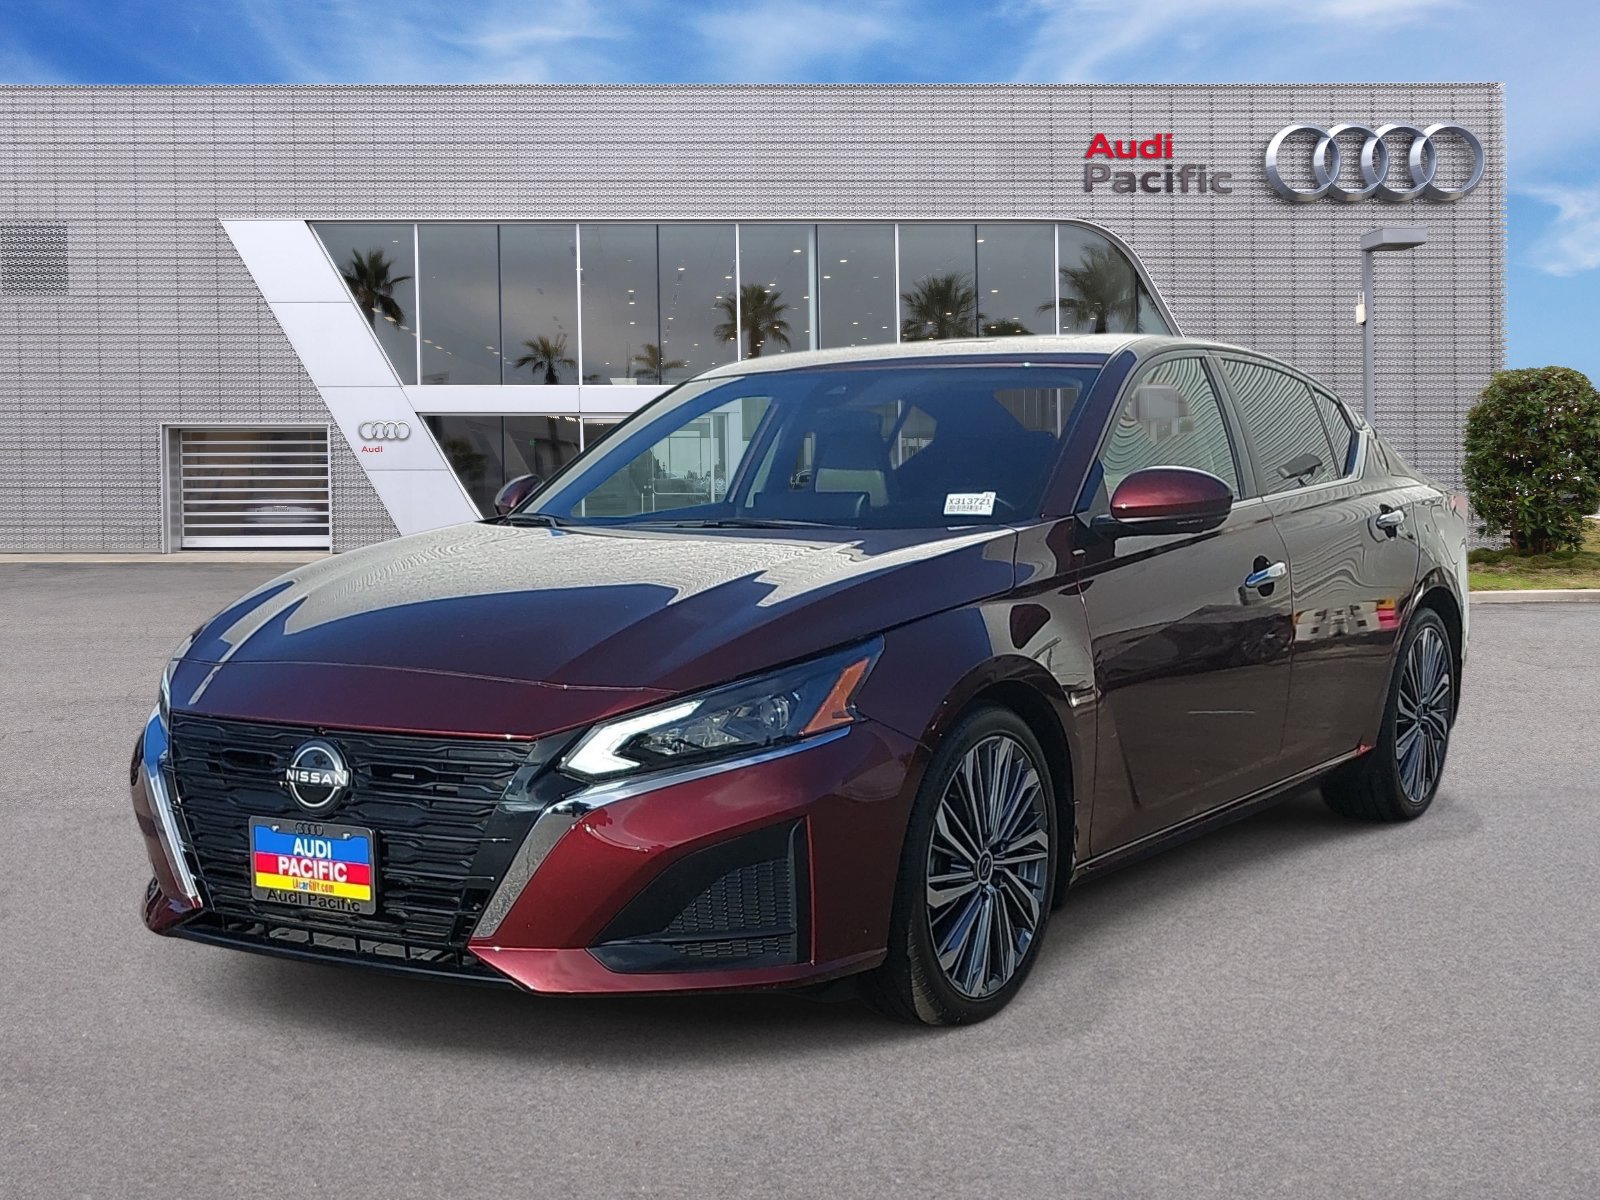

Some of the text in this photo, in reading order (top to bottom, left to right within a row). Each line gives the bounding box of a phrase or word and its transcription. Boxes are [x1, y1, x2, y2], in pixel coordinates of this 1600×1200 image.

[1084, 132, 1174, 159] Audi
[1083, 163, 1233, 194] Pacific
[948, 497, 991, 506] X313721
[286, 769, 349, 786] NISSAN
[293, 837, 332, 859] AUDI
[277, 856, 348, 882] PACIFIC
[266, 889, 361, 912] Audi Pacific
